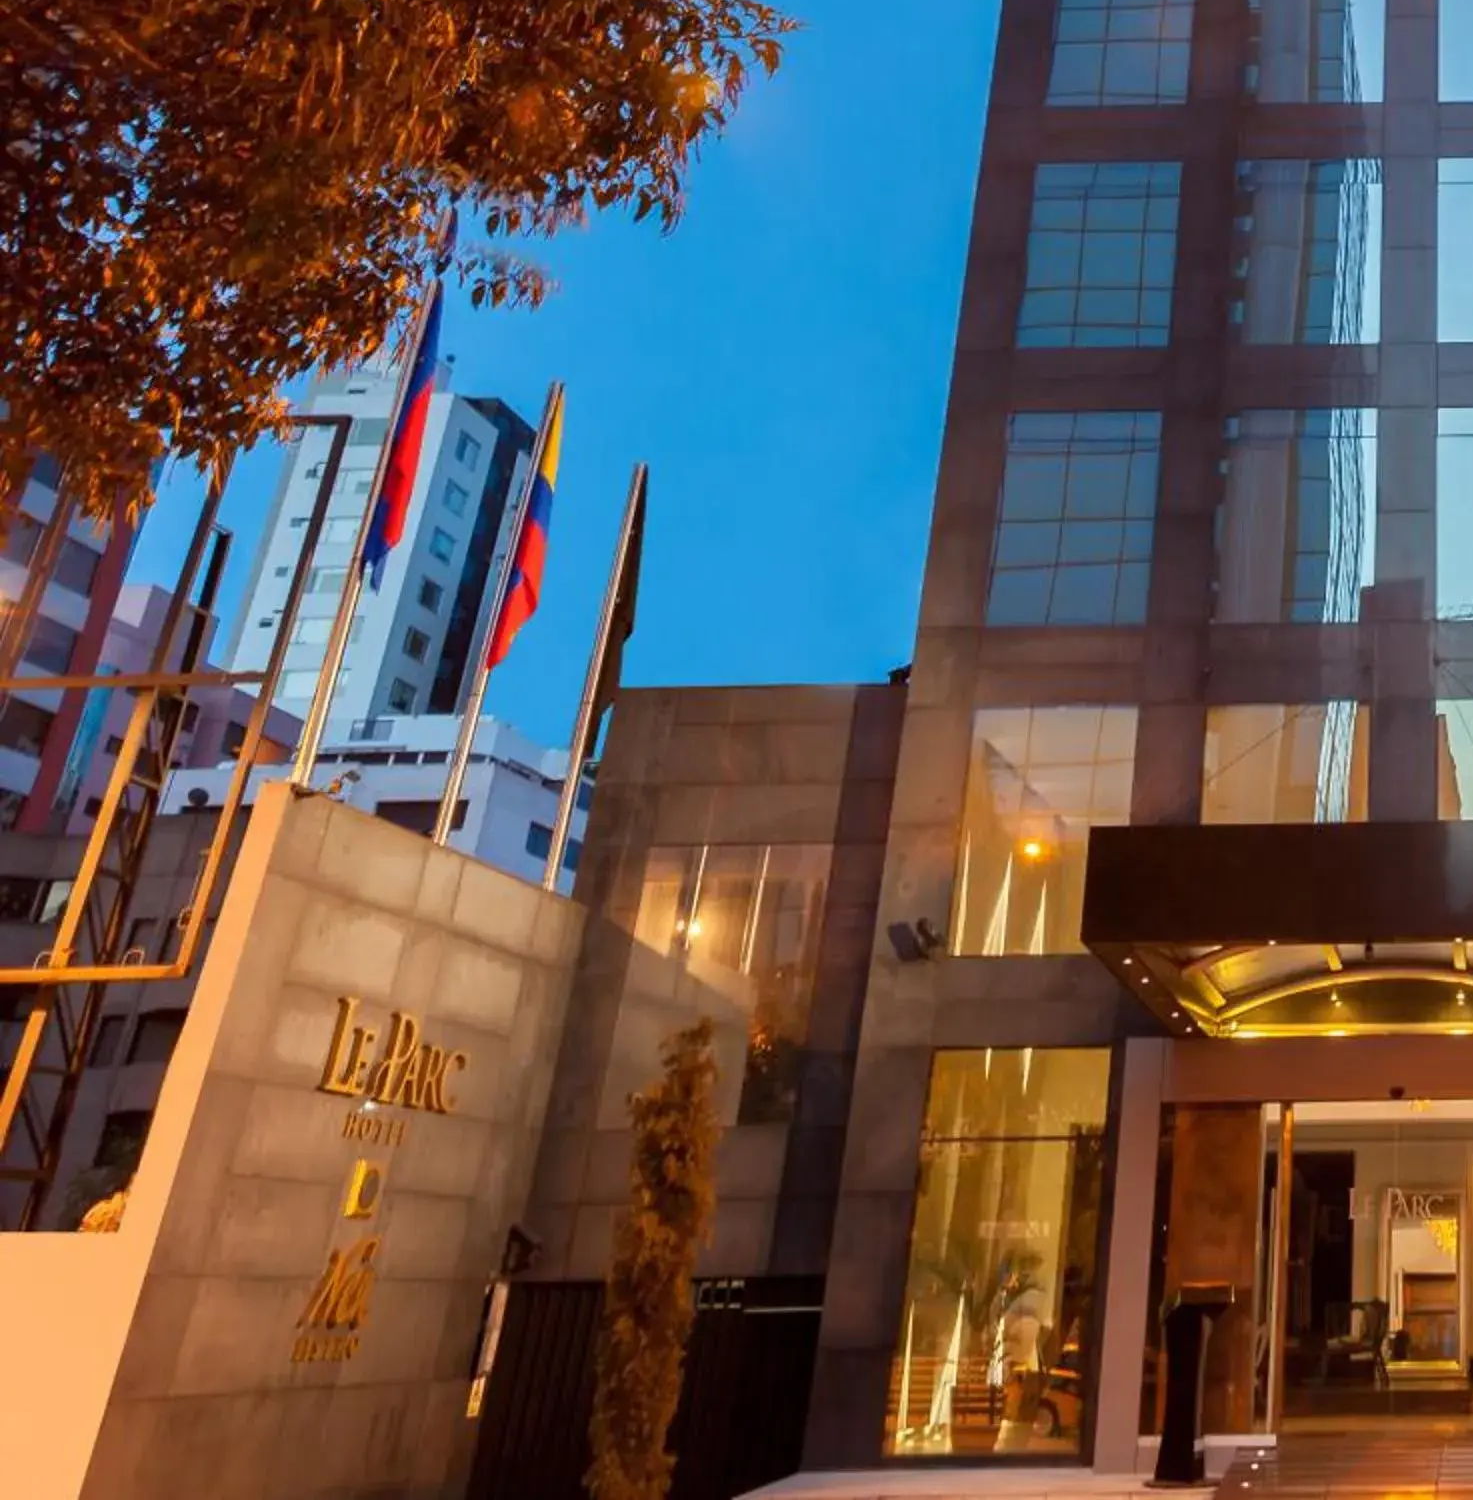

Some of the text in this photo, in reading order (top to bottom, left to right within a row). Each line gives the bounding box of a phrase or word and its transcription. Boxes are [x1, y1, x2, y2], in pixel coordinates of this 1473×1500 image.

[317, 997, 471, 1114] LE PARC
[1387, 1187, 1444, 1221] PARC
